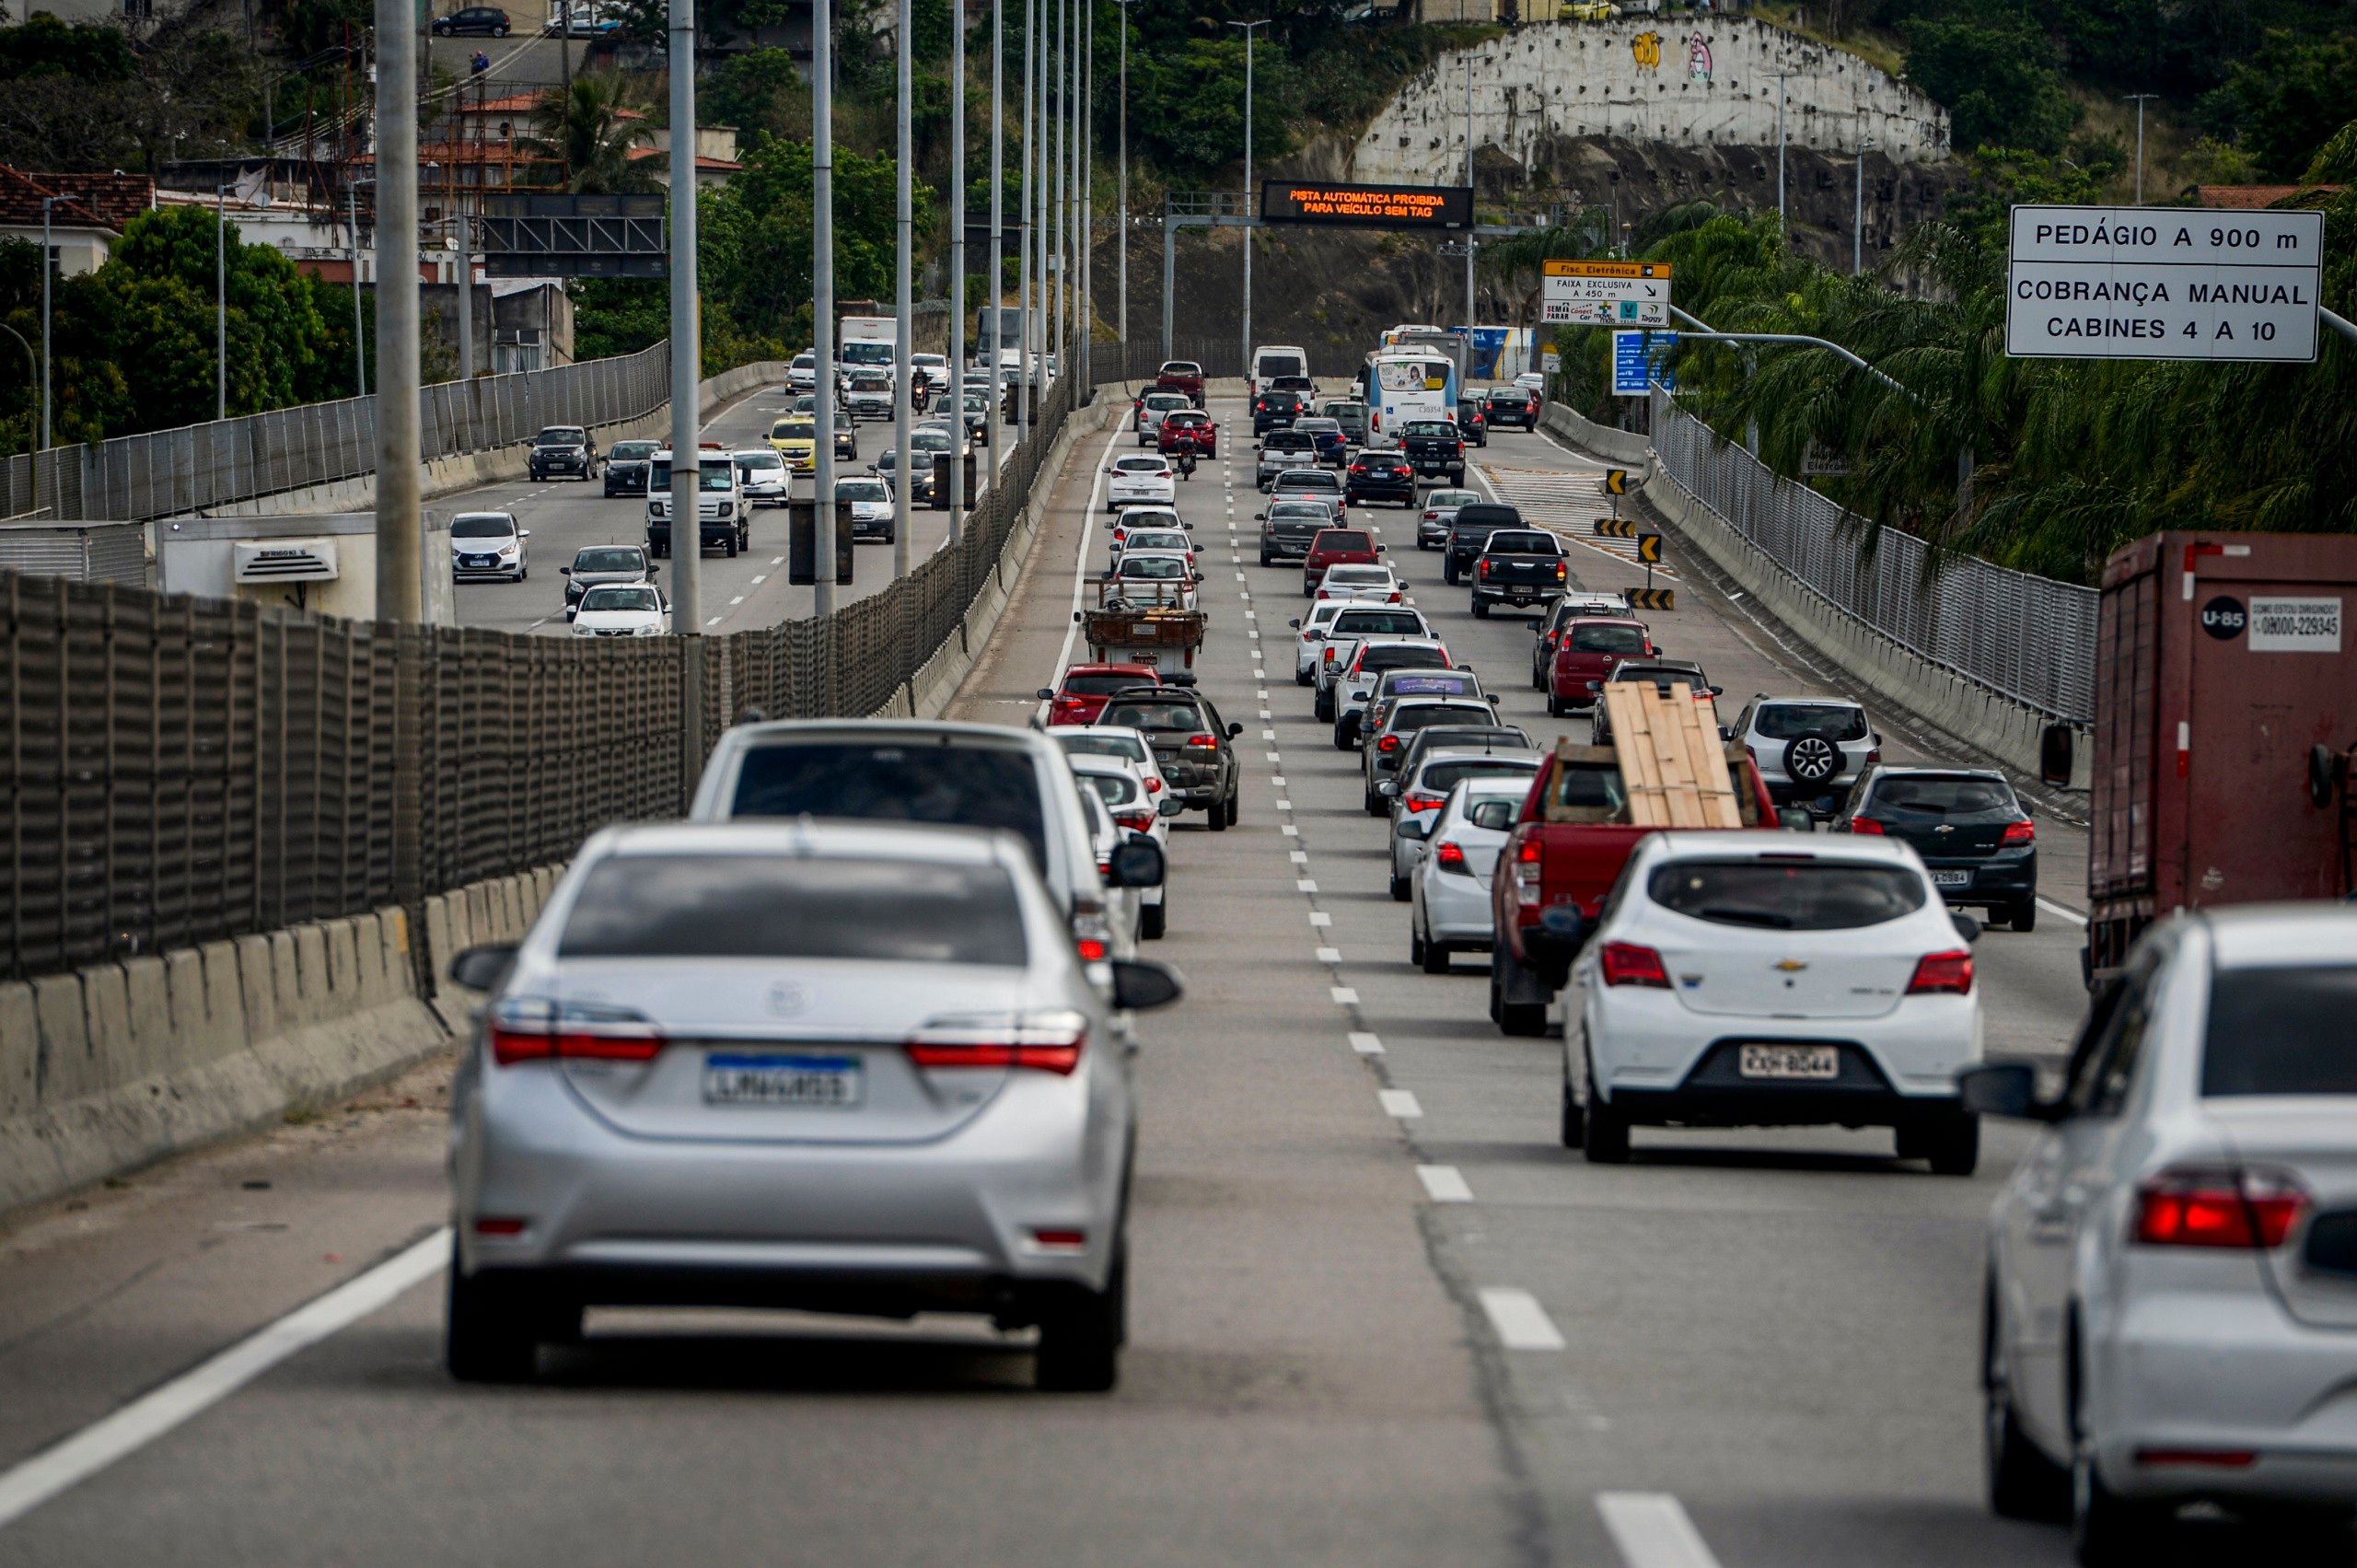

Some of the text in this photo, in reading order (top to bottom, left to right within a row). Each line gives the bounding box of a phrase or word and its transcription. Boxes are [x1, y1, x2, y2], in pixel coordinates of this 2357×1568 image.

[1290, 191, 1444, 206] PISTA AUTOMÁTICA PROIBIDA
[1304, 203, 1433, 217] PARA VEÍCULO SEM TAG
[2037, 216, 2297, 249] PEDÁGIO A 900 m
[1586, 266, 1636, 274] Eletrônica
[1557, 280, 1632, 289] FAIXA EXCLUSIVA
[2017, 280, 2308, 307] COBRANÇA MANUAL
[1547, 305, 1562, 313] SEM
[1641, 314, 1663, 323] Taggy
[2047, 317, 2276, 341] CABINES 4 A 10
[2202, 610, 2244, 627] U-85
